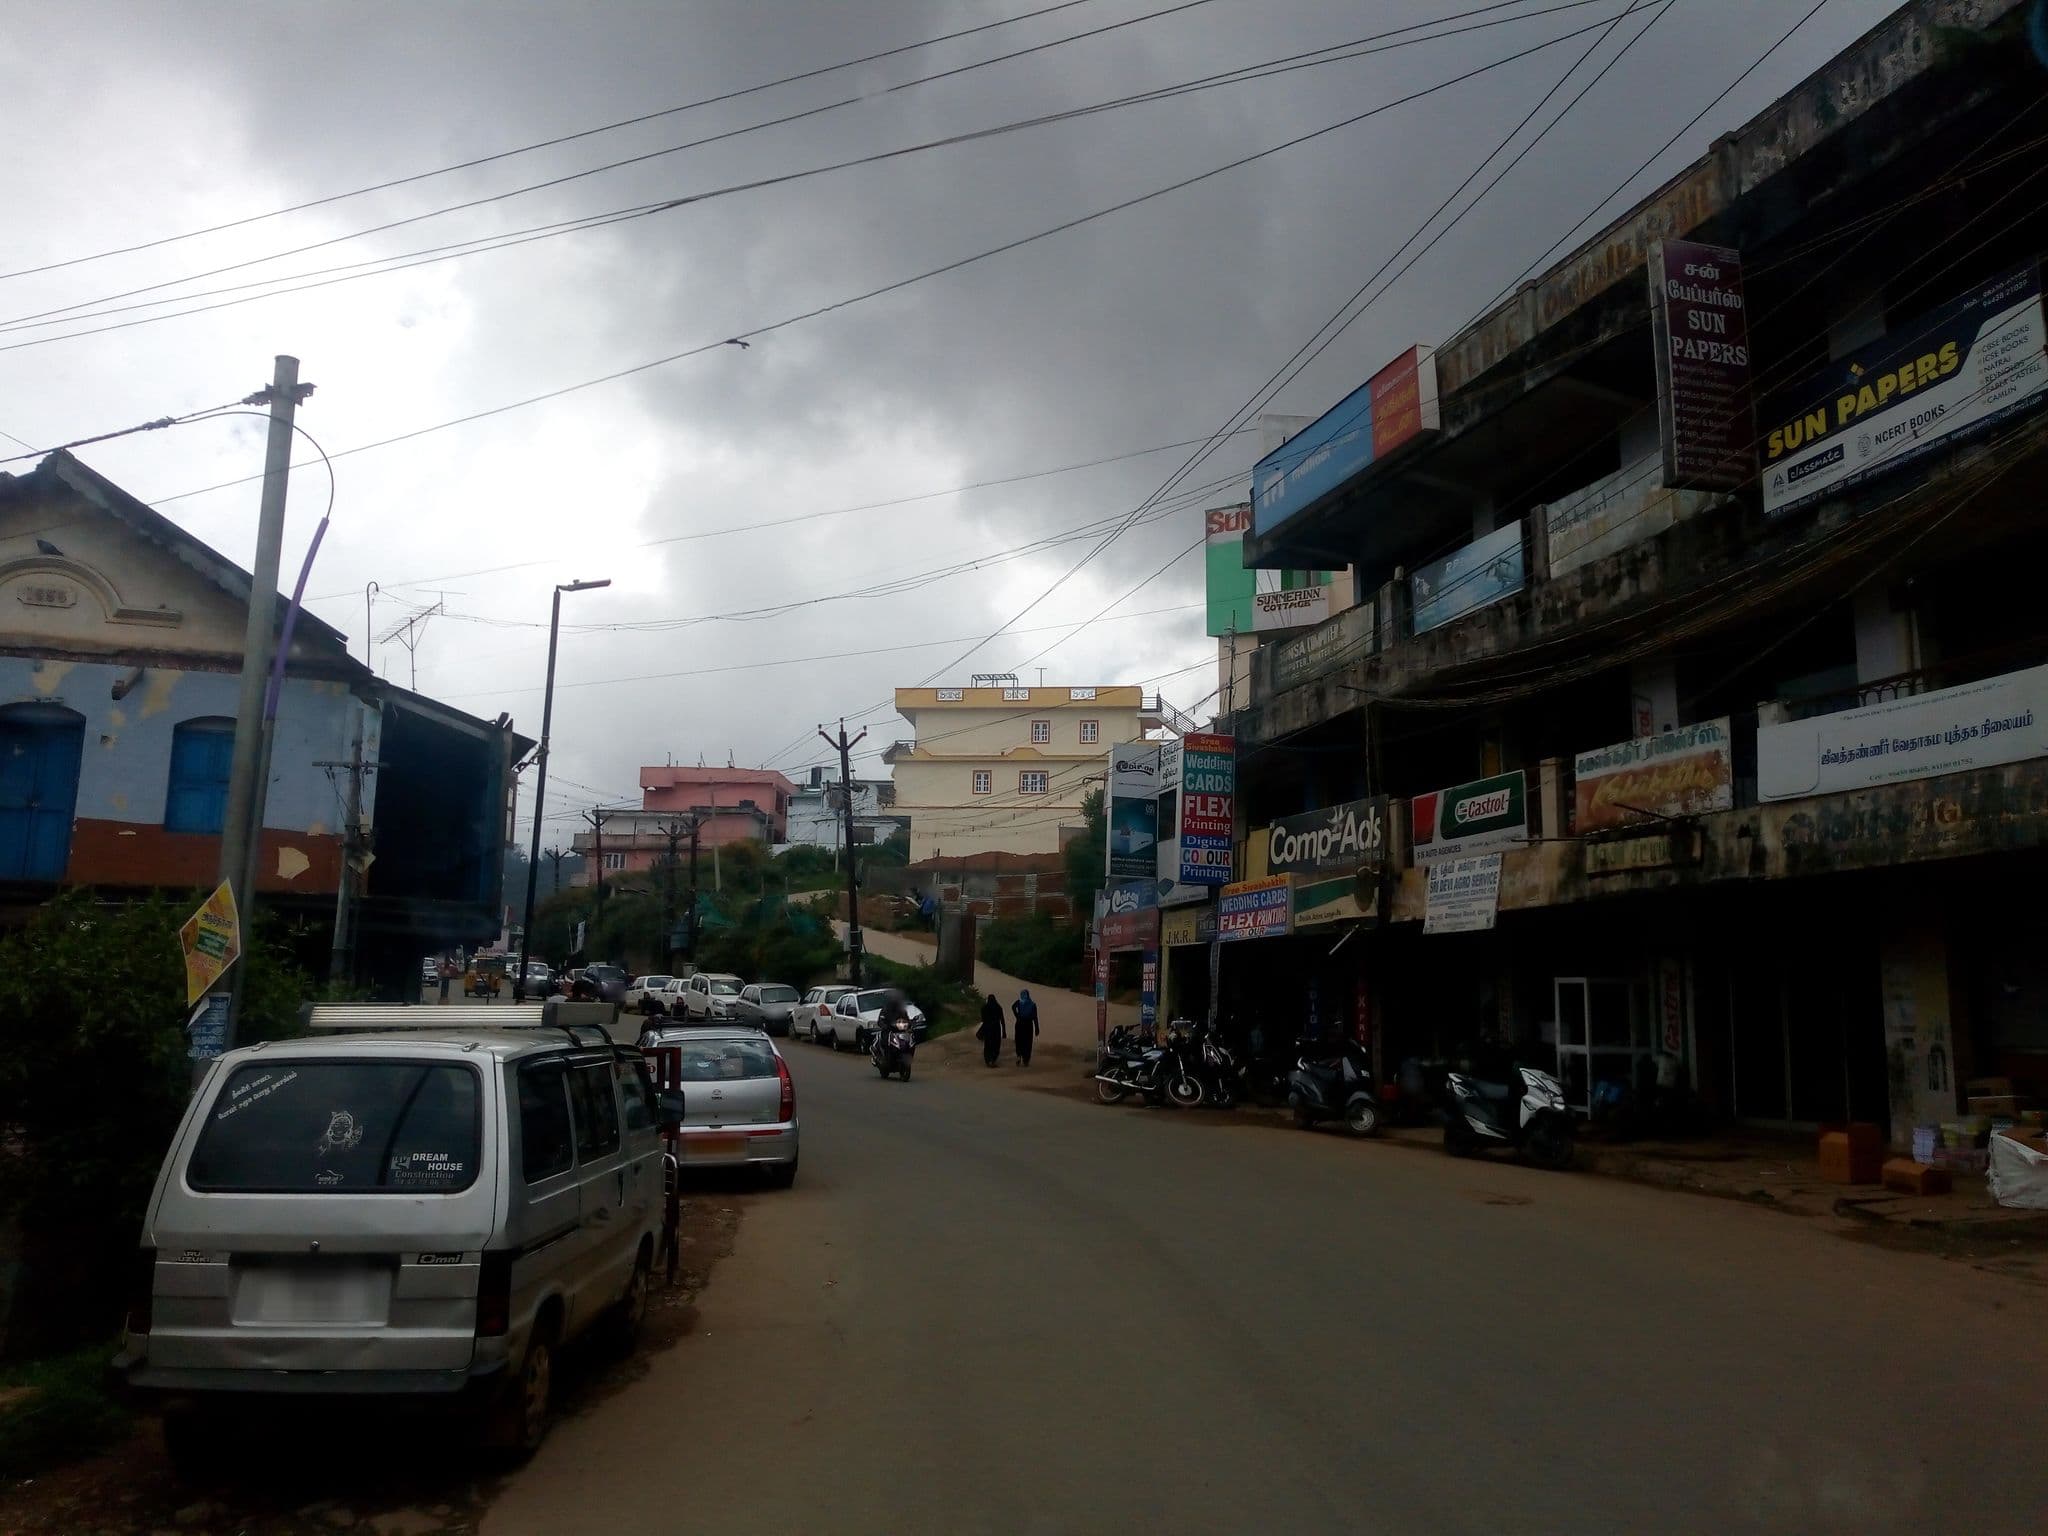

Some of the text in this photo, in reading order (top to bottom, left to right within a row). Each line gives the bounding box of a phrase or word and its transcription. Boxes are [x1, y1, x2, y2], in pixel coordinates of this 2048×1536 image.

[1684, 263, 1720, 280] சன்
[1687, 309, 1727, 334] SUN
[1671, 336, 1748, 366] PAPERS
[1768, 408, 1827, 459] SUN
[1836, 340, 1960, 425] PAPERS
[1875, 404, 1946, 446] NCERT BOOKS
[1789, 449, 1843, 480] classmate
[1263, 600, 1312, 613] COTTAGE
[1821, 708, 2034, 765] ஜீவத்தண்ணீர் வேதாகம புத்தக நிலையம்
[1185, 754, 1233, 774] Wedding
[1185, 773, 1232, 793] CARDS
[1185, 795, 1232, 818] FLEX
[1468, 793, 1505, 819] Castrol
[1184, 817, 1232, 836] Printing
[1270, 806, 1382, 866] Comp-Ads
[1186, 835, 1229, 848] Digital
[1183, 865, 1230, 882] Printing
[1471, 871, 1498, 888] SERVICE
[1220, 894, 1258, 912] WEDDING
[1259, 888, 1287, 906] CARDS
[1219, 911, 1256, 932] FLEX
[1257, 905, 1287, 927] PRINTING
[411, 1153, 449, 1162] DREAM
[427, 1163, 463, 1171] HOUSE
[395, 1170, 454, 1179] Construction
[420, 1254, 462, 1264] Omni
